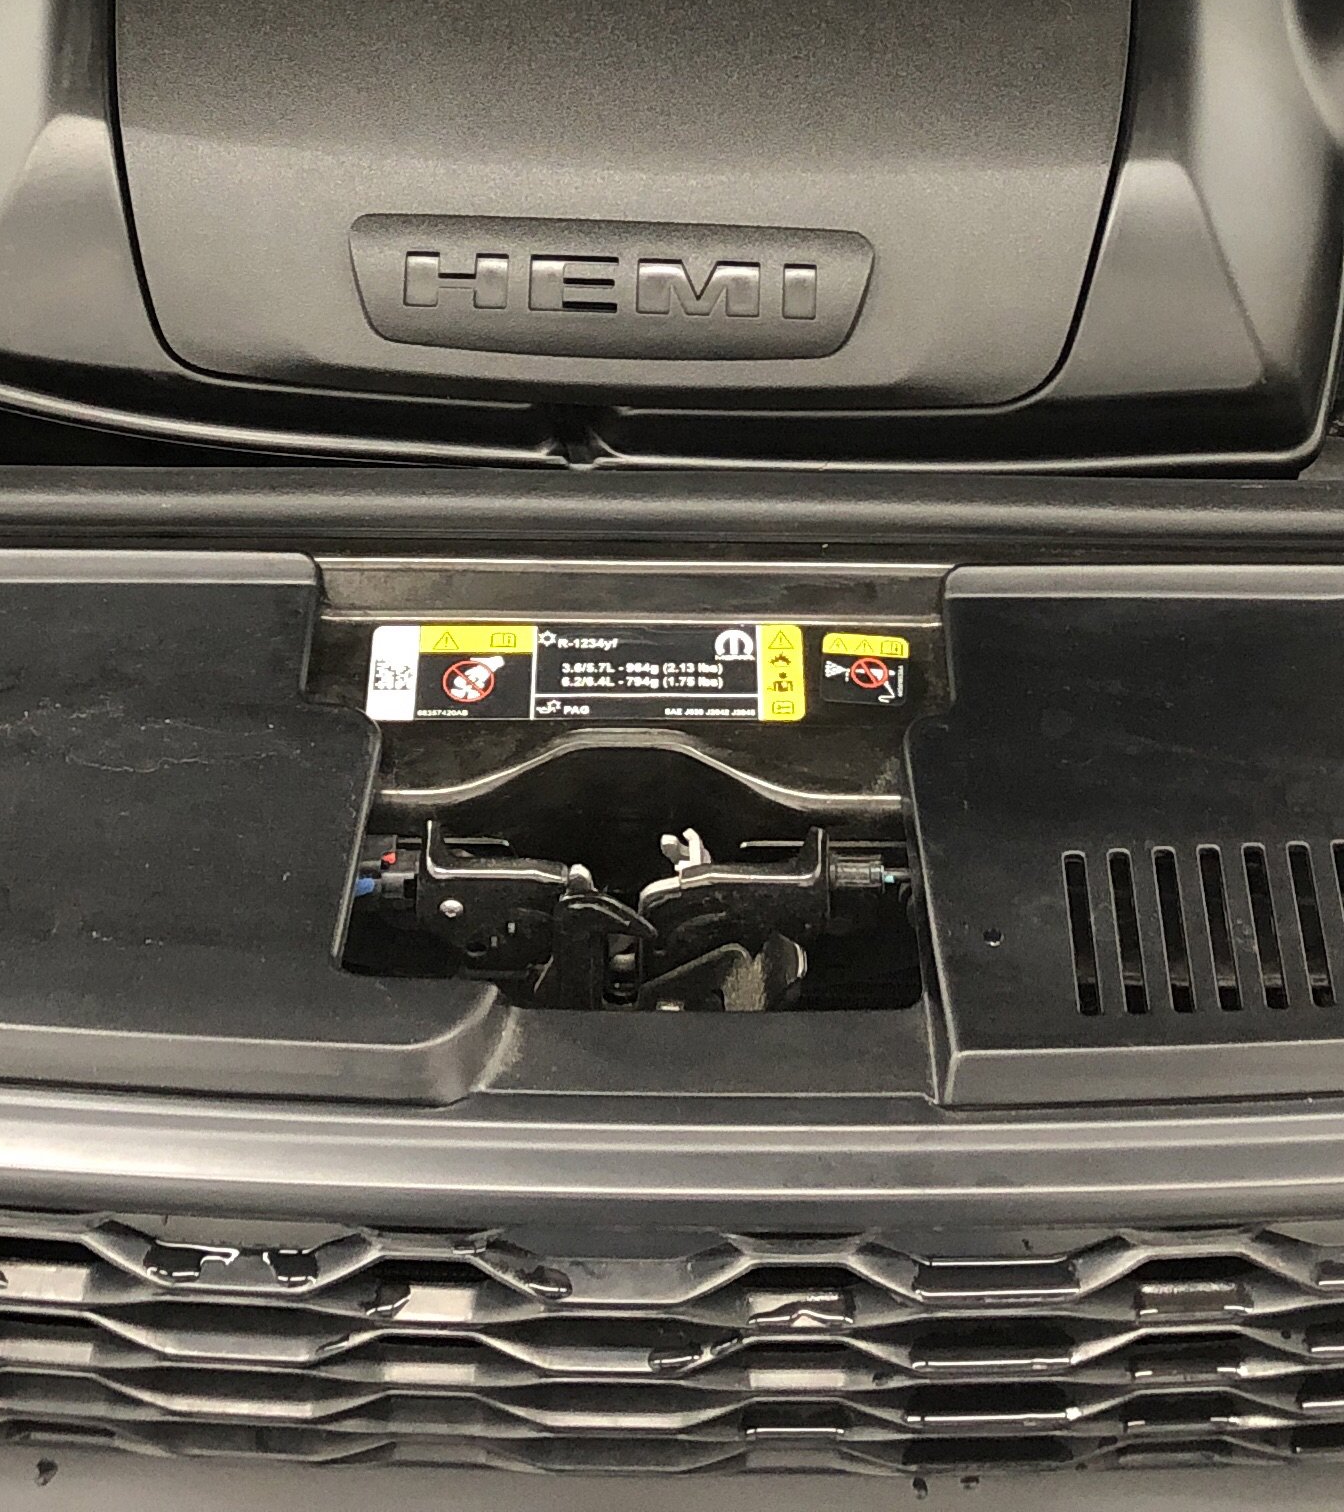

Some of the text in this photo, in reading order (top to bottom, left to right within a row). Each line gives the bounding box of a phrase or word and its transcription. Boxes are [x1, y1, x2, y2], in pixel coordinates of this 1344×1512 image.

[403, 250, 818, 320] HEMI
[557, 638, 619, 651] R-1234yf
[562, 705, 590, 715] PAG
